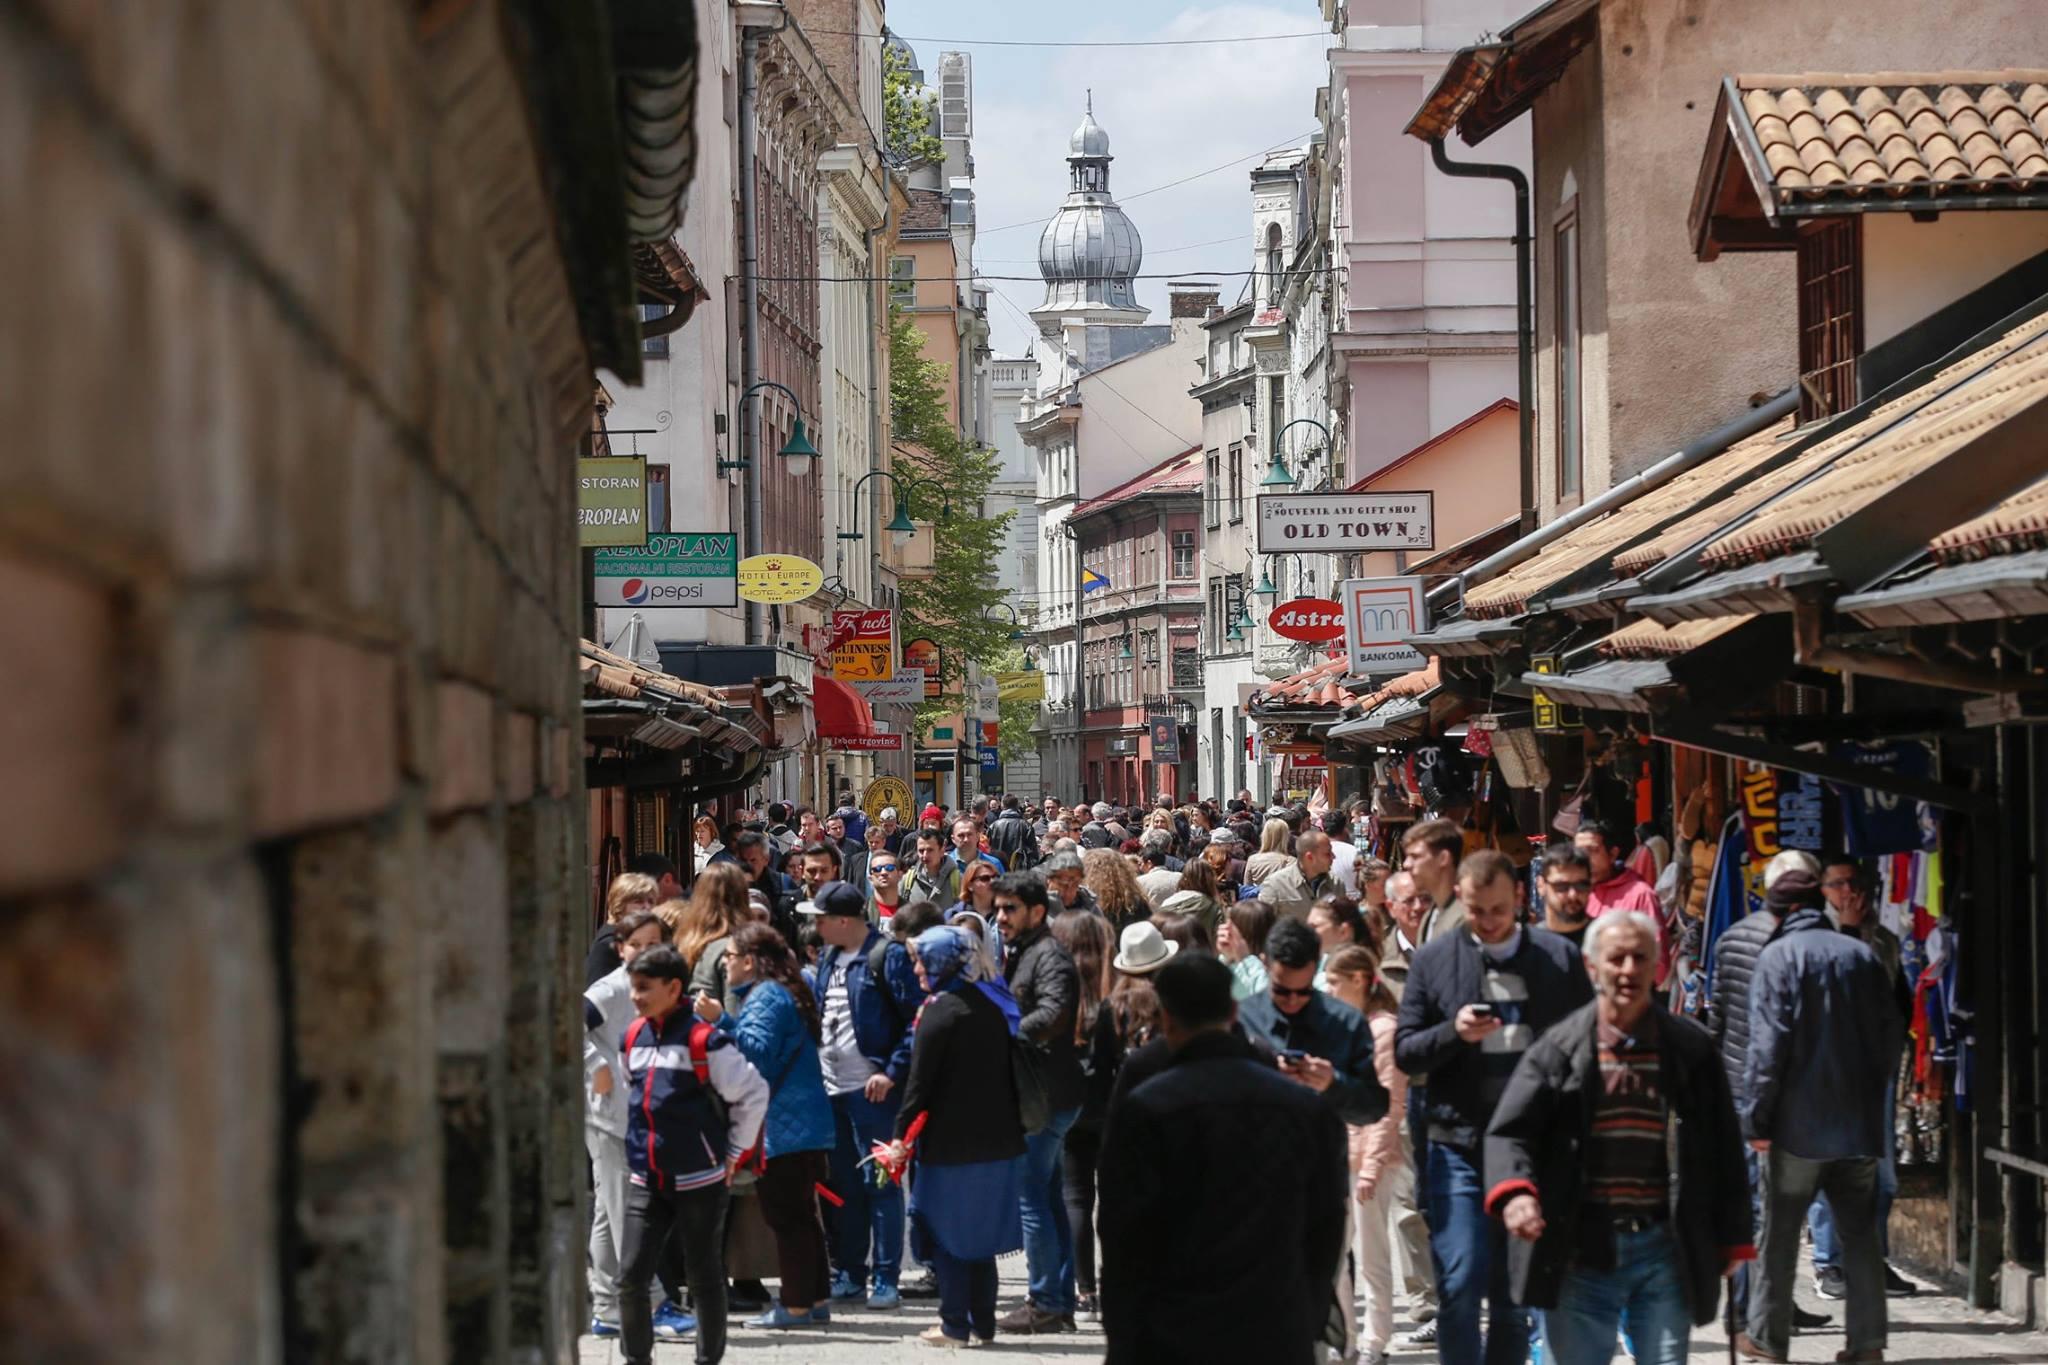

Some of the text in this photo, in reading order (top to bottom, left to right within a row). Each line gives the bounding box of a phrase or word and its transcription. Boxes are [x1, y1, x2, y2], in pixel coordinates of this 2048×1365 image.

[577, 477, 640, 489] STORAN
[1274, 507, 1330, 516] SOUVENIR
[1334, 507, 1355, 515] AND
[1357, 506, 1385, 514] GIFT
[1389, 506, 1417, 514] SHOP
[1284, 523, 1329, 539] OLD
[1338, 522, 1408, 538] TOWN
[739, 572, 772, 580] HOTEL
[651, 583, 703, 601] pepsi
[1276, 610, 1344, 627] Astra
[834, 655, 855, 665] PUB
[1360, 650, 1418, 662] BANKOMAT
